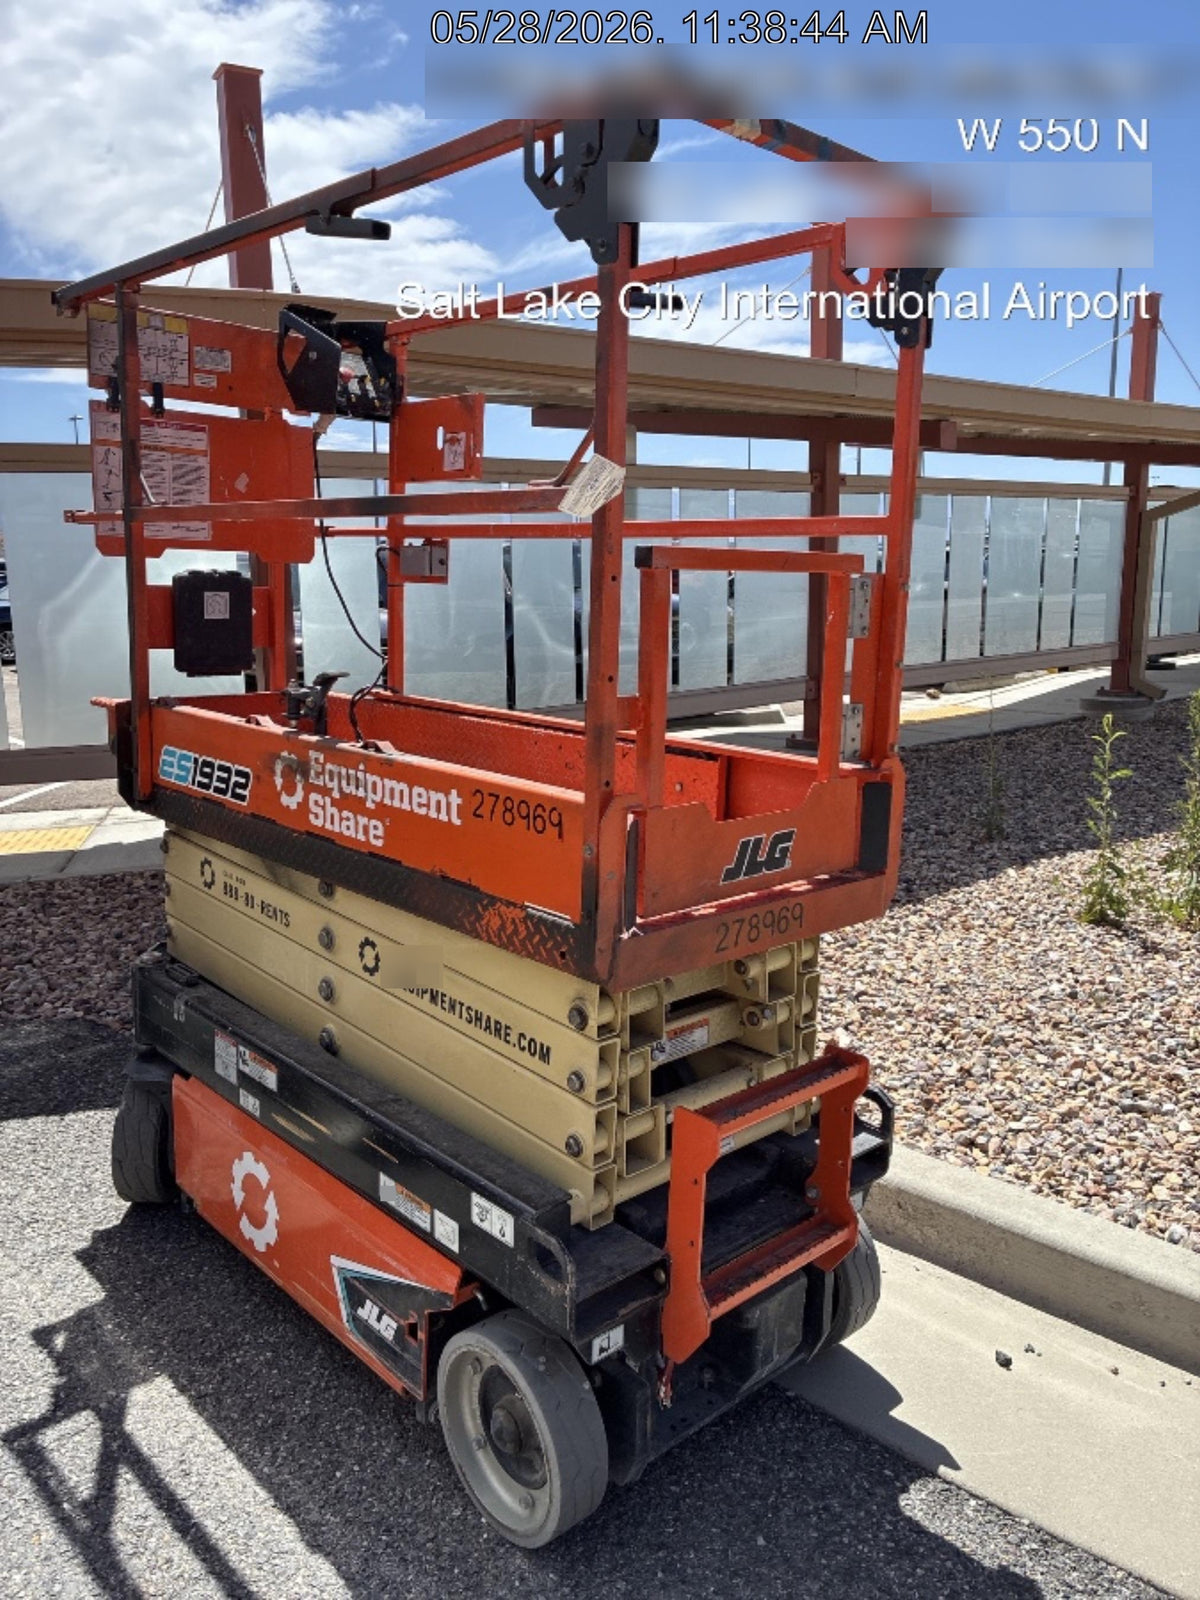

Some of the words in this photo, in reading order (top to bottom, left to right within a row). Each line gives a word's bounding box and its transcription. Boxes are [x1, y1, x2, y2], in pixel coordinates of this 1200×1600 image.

[308, 749, 463, 826] Equipment
[472, 788, 564, 842] 278969
[308, 792, 385, 848] Share
[720, 828, 797, 885] JLG
[715, 902, 804, 952] 278969
[356, 1298, 398, 1341] JLG
